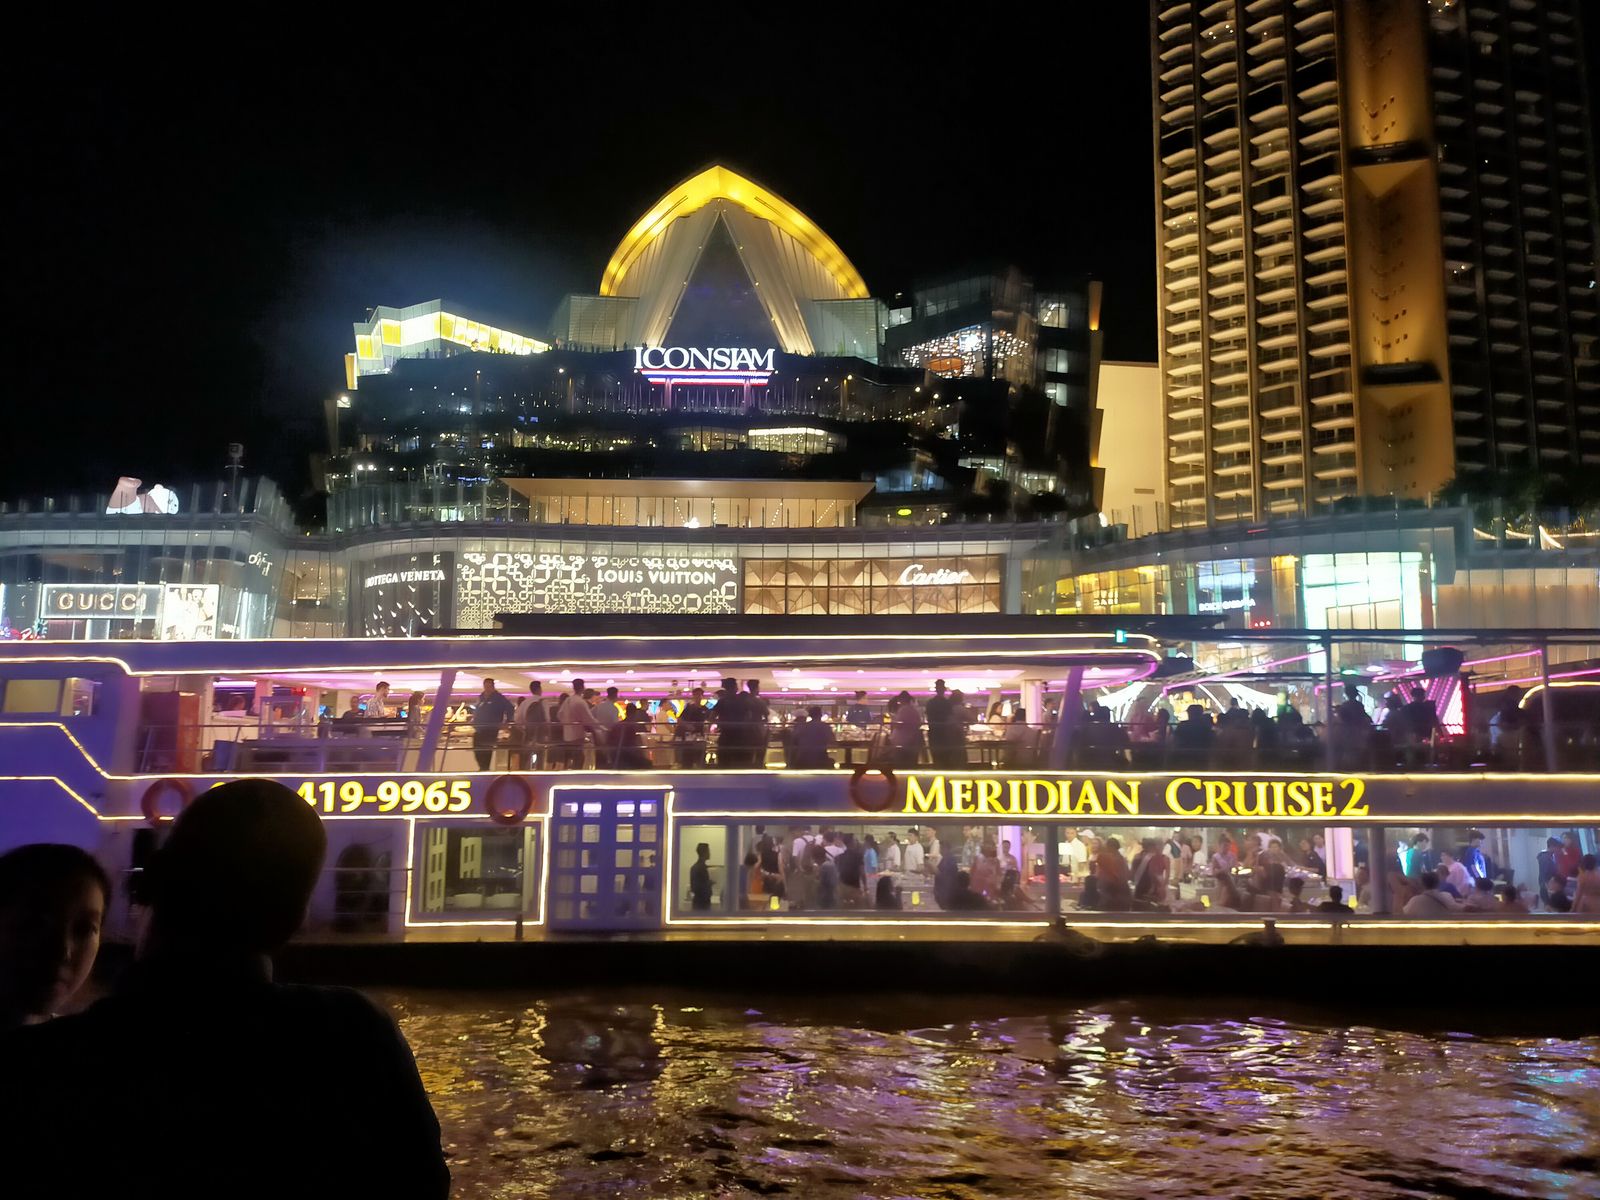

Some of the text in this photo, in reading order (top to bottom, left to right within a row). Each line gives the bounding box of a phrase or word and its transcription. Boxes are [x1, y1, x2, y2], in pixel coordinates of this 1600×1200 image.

[634, 346, 775, 370] ICONSIAM
[400, 569, 445, 582] VENETA
[597, 569, 716, 585] LOUIS VUITTON
[901, 564, 969, 585] Cartier
[58, 592, 146, 611] GUCCI
[209, 780, 472, 813] 419-9965
[902, 775, 1140, 815] MERIDIAN
